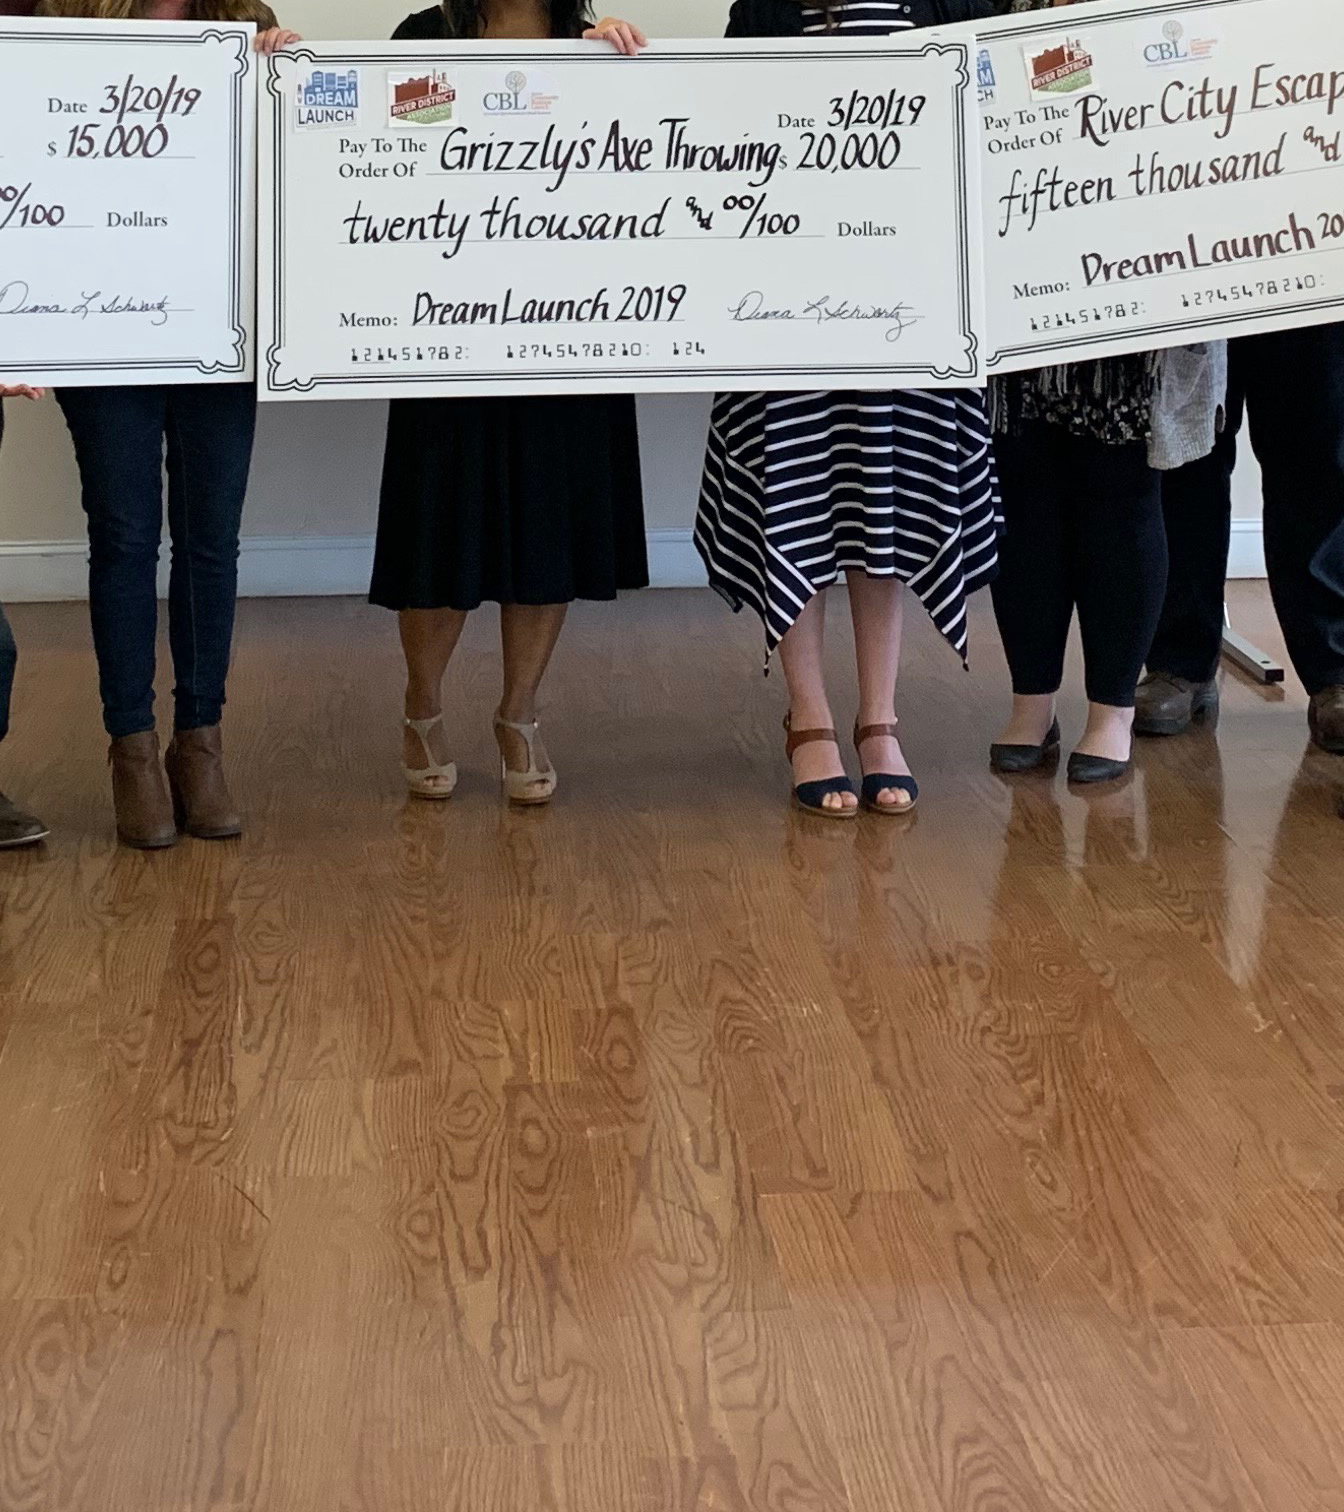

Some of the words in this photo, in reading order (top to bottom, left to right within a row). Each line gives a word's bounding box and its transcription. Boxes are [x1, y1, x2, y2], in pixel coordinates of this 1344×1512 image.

[1143, 40, 1188, 62] CBL
[47, 98, 88, 113] Date
[98, 74, 202, 124] 3/20/19
[306, 90, 356, 107] DREAM
[392, 101, 416, 115] RIVER
[418, 91, 454, 108] DISTRICT
[483, 92, 527, 111] CBL
[777, 113, 815, 128] Date
[827, 88, 926, 130] 3/20/19
[298, 108, 355, 125] LAUNCH
[984, 115, 1011, 131] Pay
[1014, 111, 1036, 126] To
[1039, 105, 1070, 122] The
[987, 137, 1036, 154] Order
[1040, 128, 1064, 145] Of
[1074, 94, 1154, 147] River
[1160, 77, 1238, 139] City
[47, 141, 57, 158] $
[67, 123, 169, 160] 15,000
[338, 138, 368, 158] Pay
[371, 138, 393, 153] To
[396, 137, 427, 153] The
[338, 163, 389, 178] Order
[393, 161, 418, 178] Of
[440, 121, 597, 192] Grizzly's
[597, 119, 653, 172] Axe
[658, 117, 782, 188] Throwing
[778, 154, 788, 170] $
[796, 130, 901, 174] 20,000
[998, 165, 1117, 238] fifteen
[1128, 132, 1288, 197] thousand
[1303, 126, 1342, 162] and
[106, 210, 168, 228] Dollars
[342, 198, 470, 259] twenty
[479, 195, 673, 240] thousand
[685, 196, 714, 231] and
[837, 221, 897, 237] Dollars
[1012, 279, 1071, 299] Memo:
[339, 312, 399, 328] Memo:
[614, 283, 688, 323] 2019
